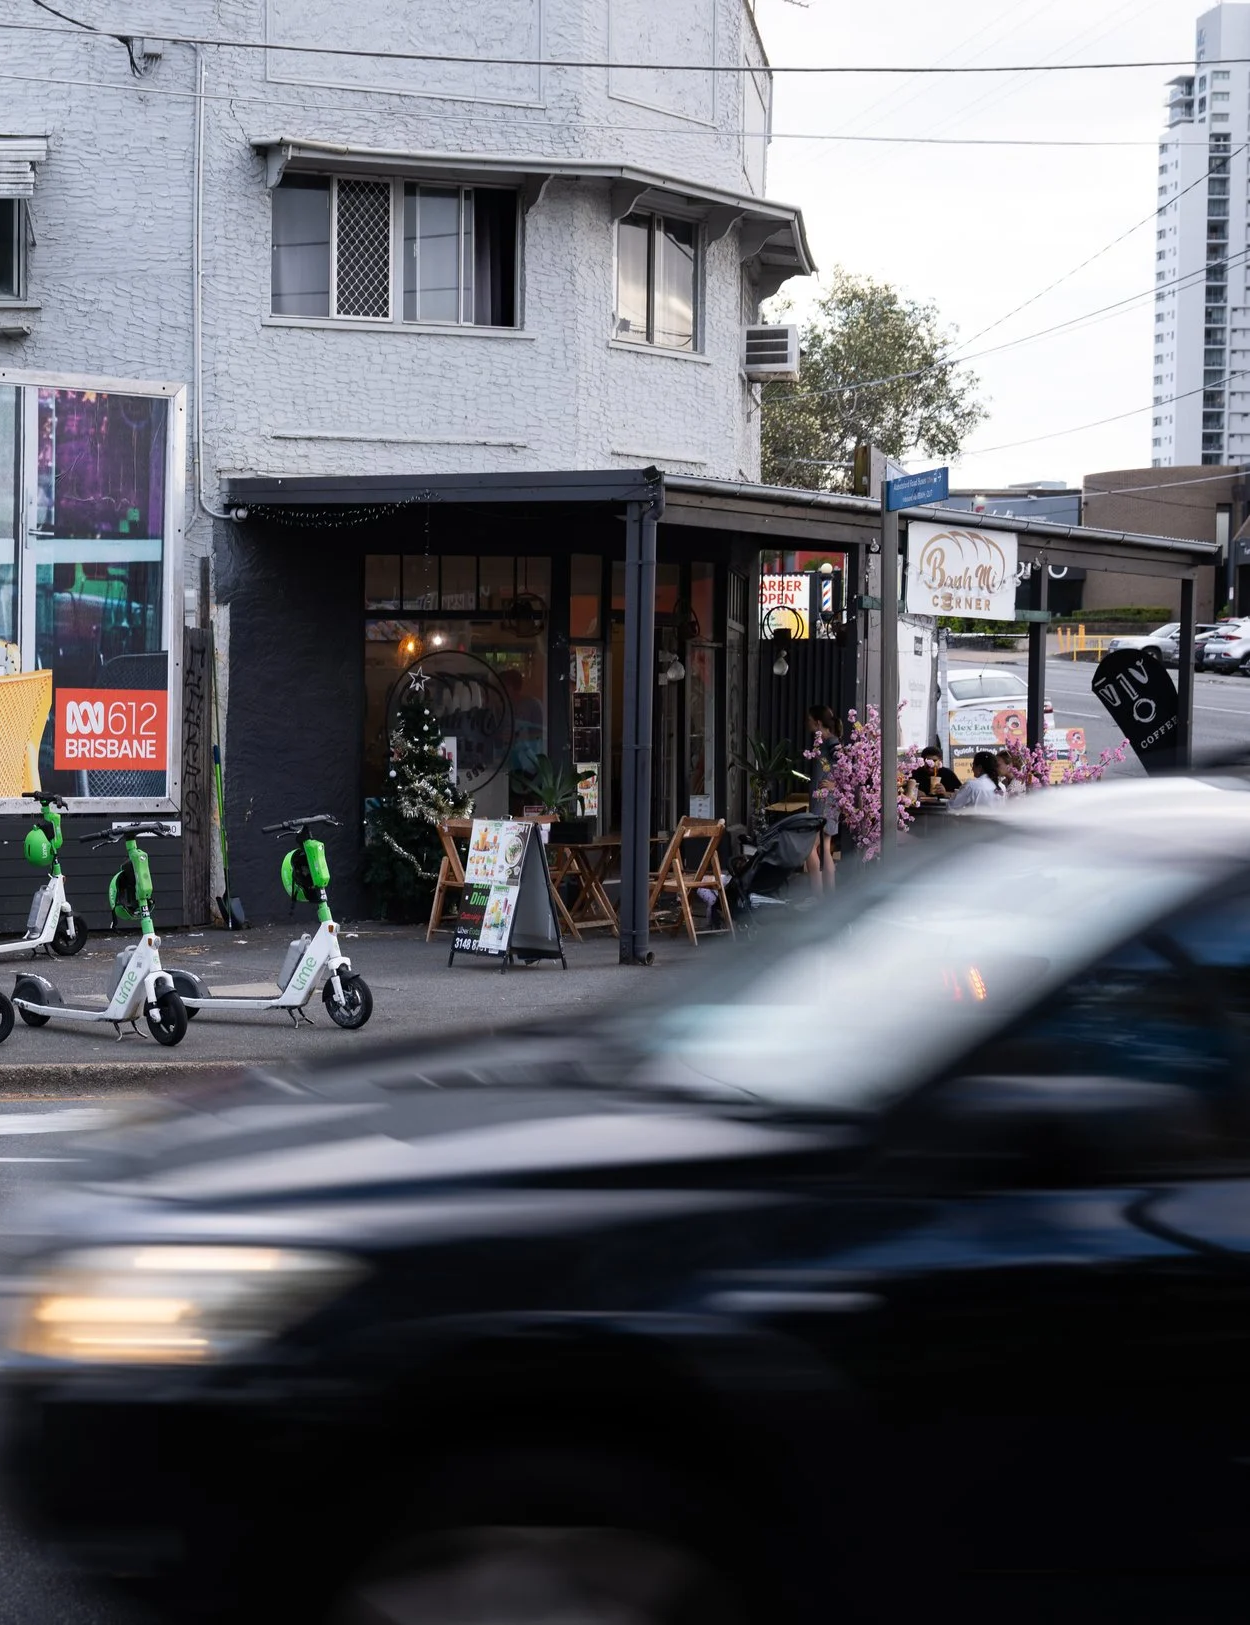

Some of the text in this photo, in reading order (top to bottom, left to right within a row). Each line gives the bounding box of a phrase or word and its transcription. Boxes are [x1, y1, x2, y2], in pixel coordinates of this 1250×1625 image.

[758, 593, 795, 605] OPEN
[759, 580, 802, 591] ARBER
[108, 701, 157, 735] 612
[65, 738, 157, 759] BRISBANE
[292, 955, 317, 991] Lime
[115, 970, 138, 1005] Lime
